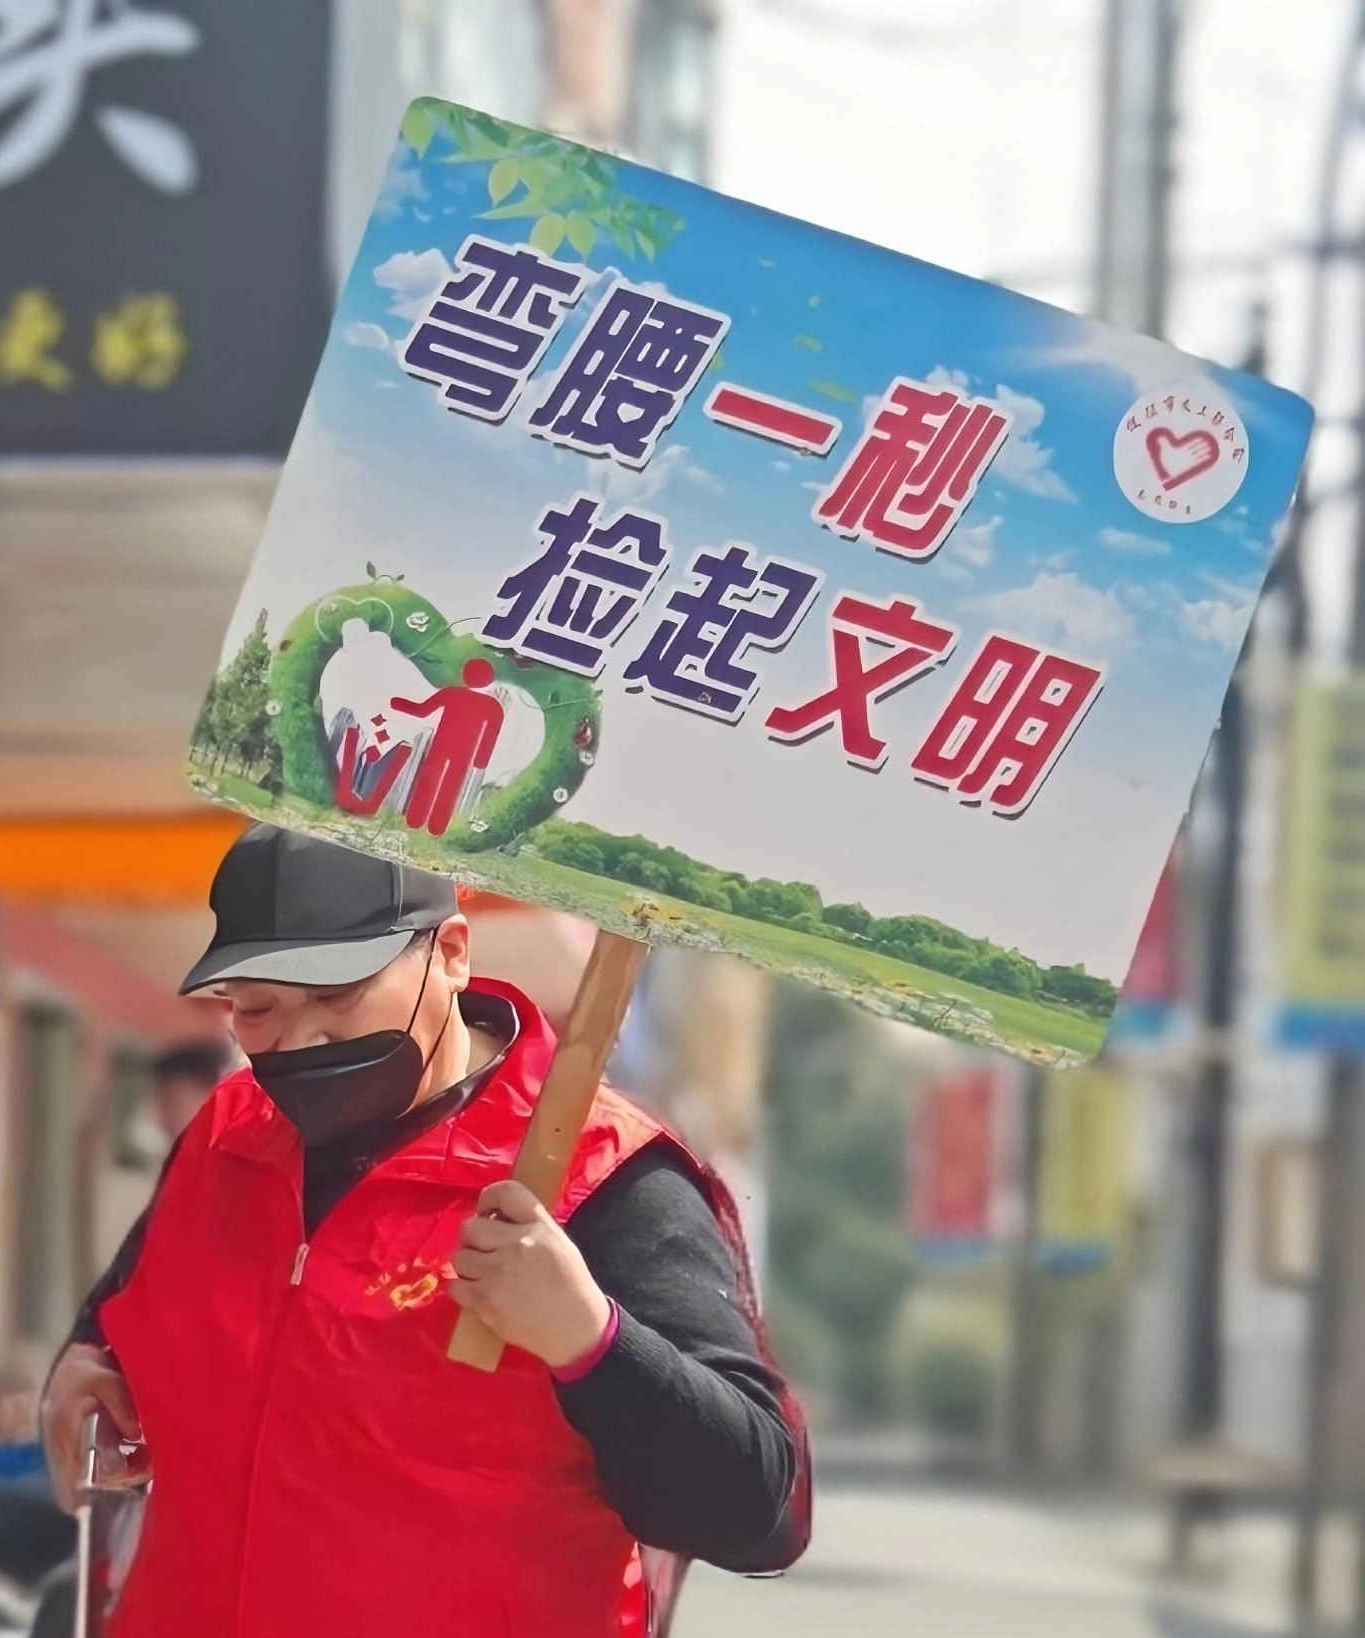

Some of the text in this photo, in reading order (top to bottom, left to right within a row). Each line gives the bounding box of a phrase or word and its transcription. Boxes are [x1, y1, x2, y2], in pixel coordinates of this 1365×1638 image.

[402, 240, 1009, 552] 弯腰一秒
[481, 497, 1103, 810] 捡起文明
